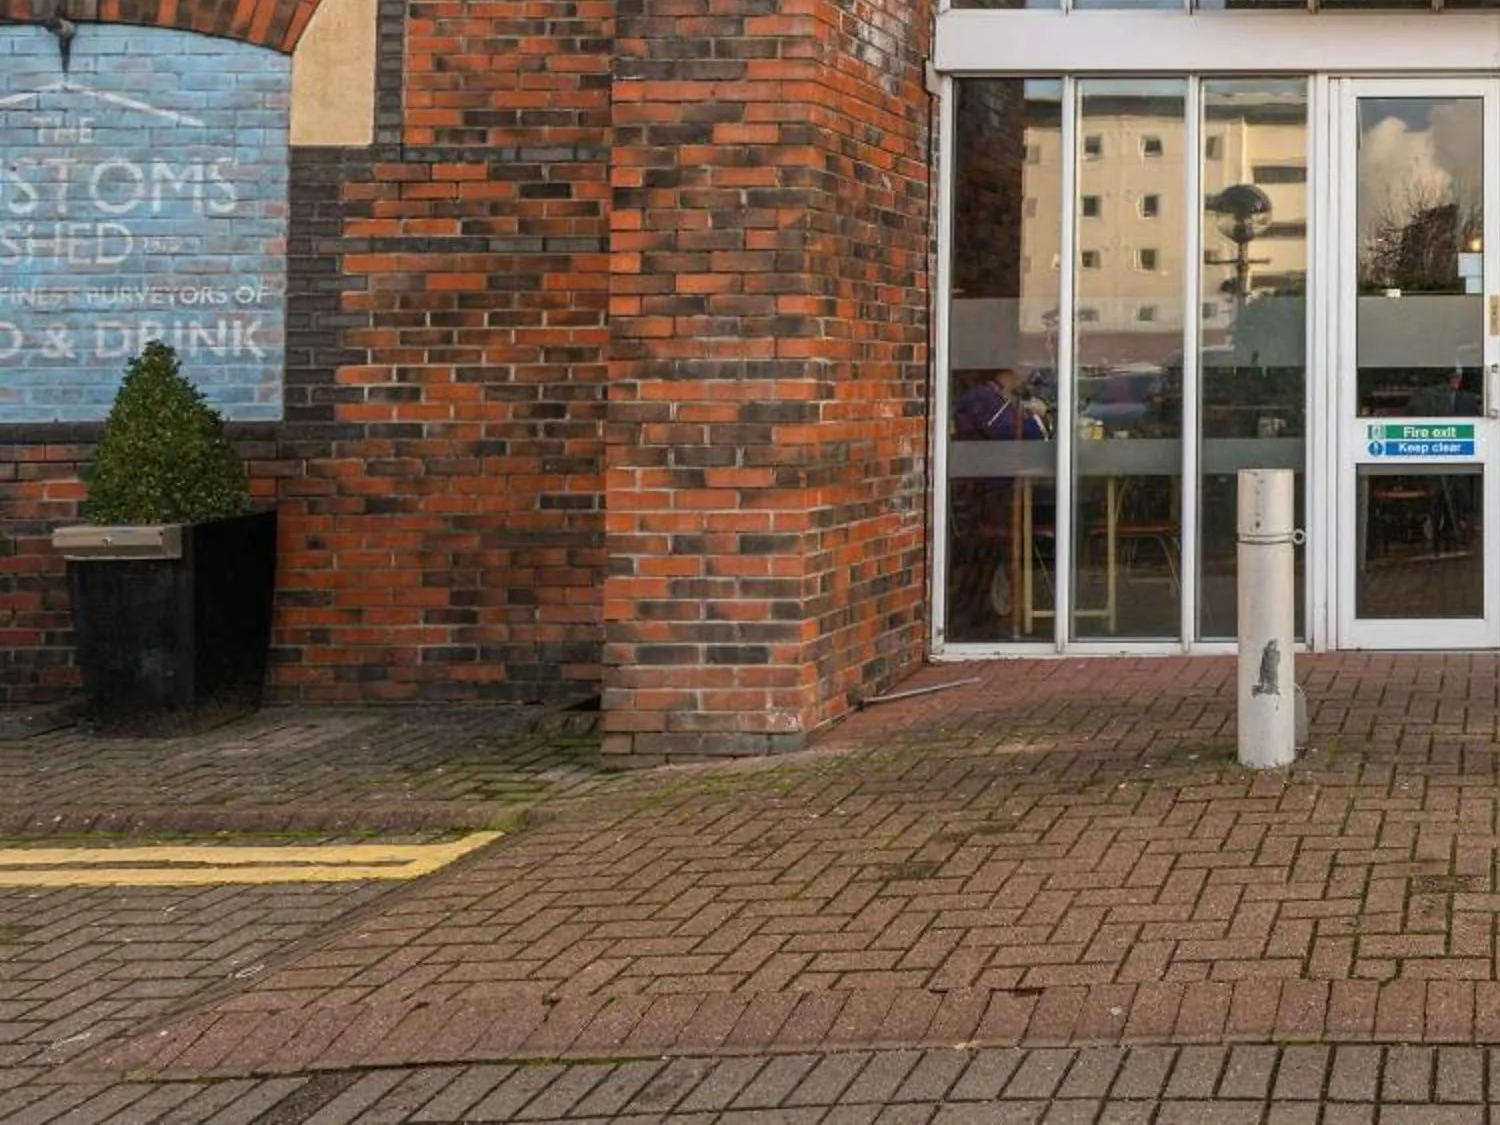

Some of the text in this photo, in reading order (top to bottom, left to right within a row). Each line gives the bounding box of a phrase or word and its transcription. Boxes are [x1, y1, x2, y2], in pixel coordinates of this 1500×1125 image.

[31, 116, 96, 144] THE
[0, 220, 134, 265] SHED
[86, 285, 228, 305] PURVEYORS
[234, 284, 271, 305] OF
[42, 323, 76, 360] &
[94, 318, 268, 360] DRINK
[1403, 426, 1457, 438] Fire exit
[1399, 442, 1461, 455] Keep clear
